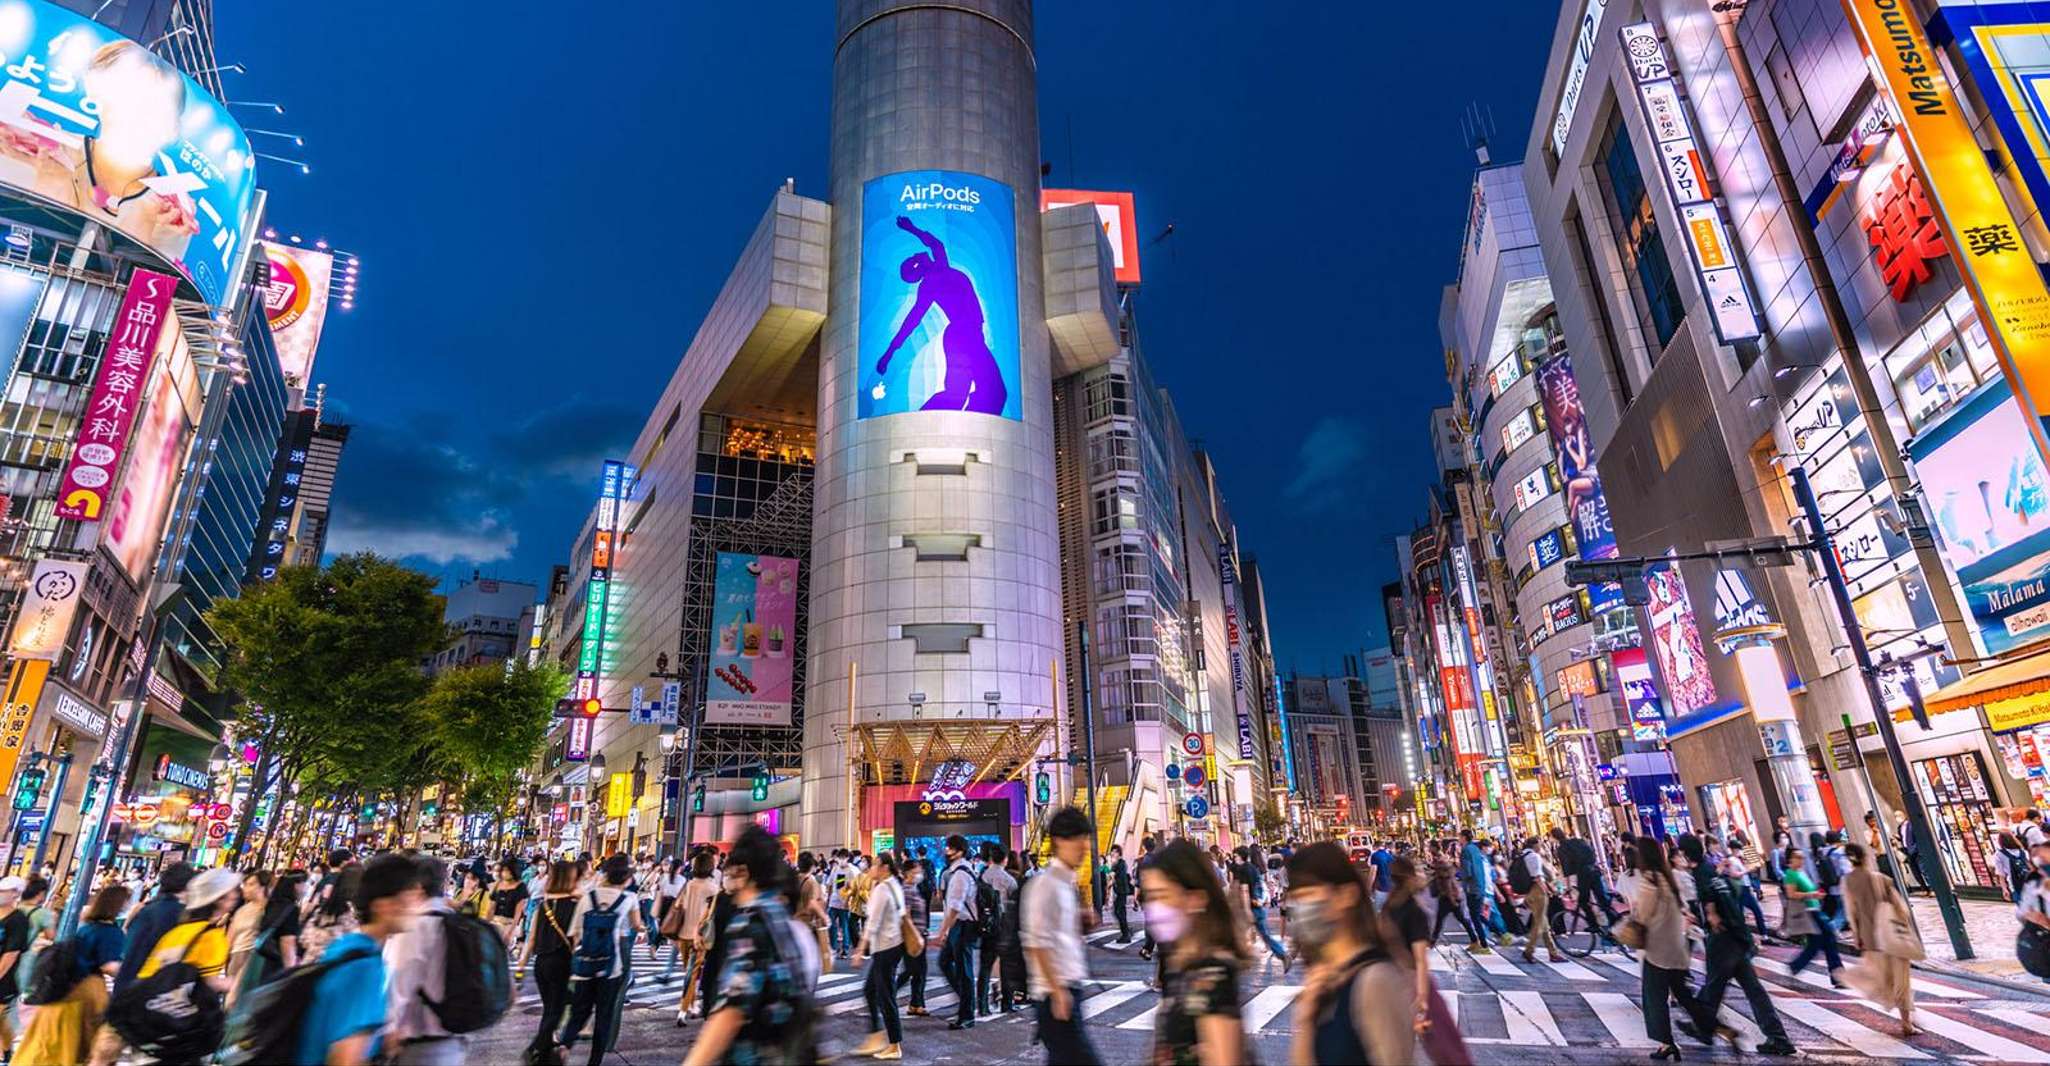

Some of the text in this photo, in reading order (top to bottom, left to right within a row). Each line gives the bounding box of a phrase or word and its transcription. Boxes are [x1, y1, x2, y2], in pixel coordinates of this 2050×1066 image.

[1566, 13, 1595, 110] Darts UP
[1637, 64, 1666, 78] UP
[900, 183, 980, 204] AirPods
[1672, 155, 1692, 200] スシロー
[1860, 161, 1951, 304] 薬
[1964, 225, 2018, 256] 薬
[88, 301, 157, 444] 品川美容外科
[1552, 375, 1577, 417] 美
[1841, 535, 1878, 564] スシロー
[1220, 555, 1232, 584] LABI
[1227, 613, 1240, 645] LABI
[1187, 738, 1199, 749] 30
[1241, 726, 1252, 759] LABI
